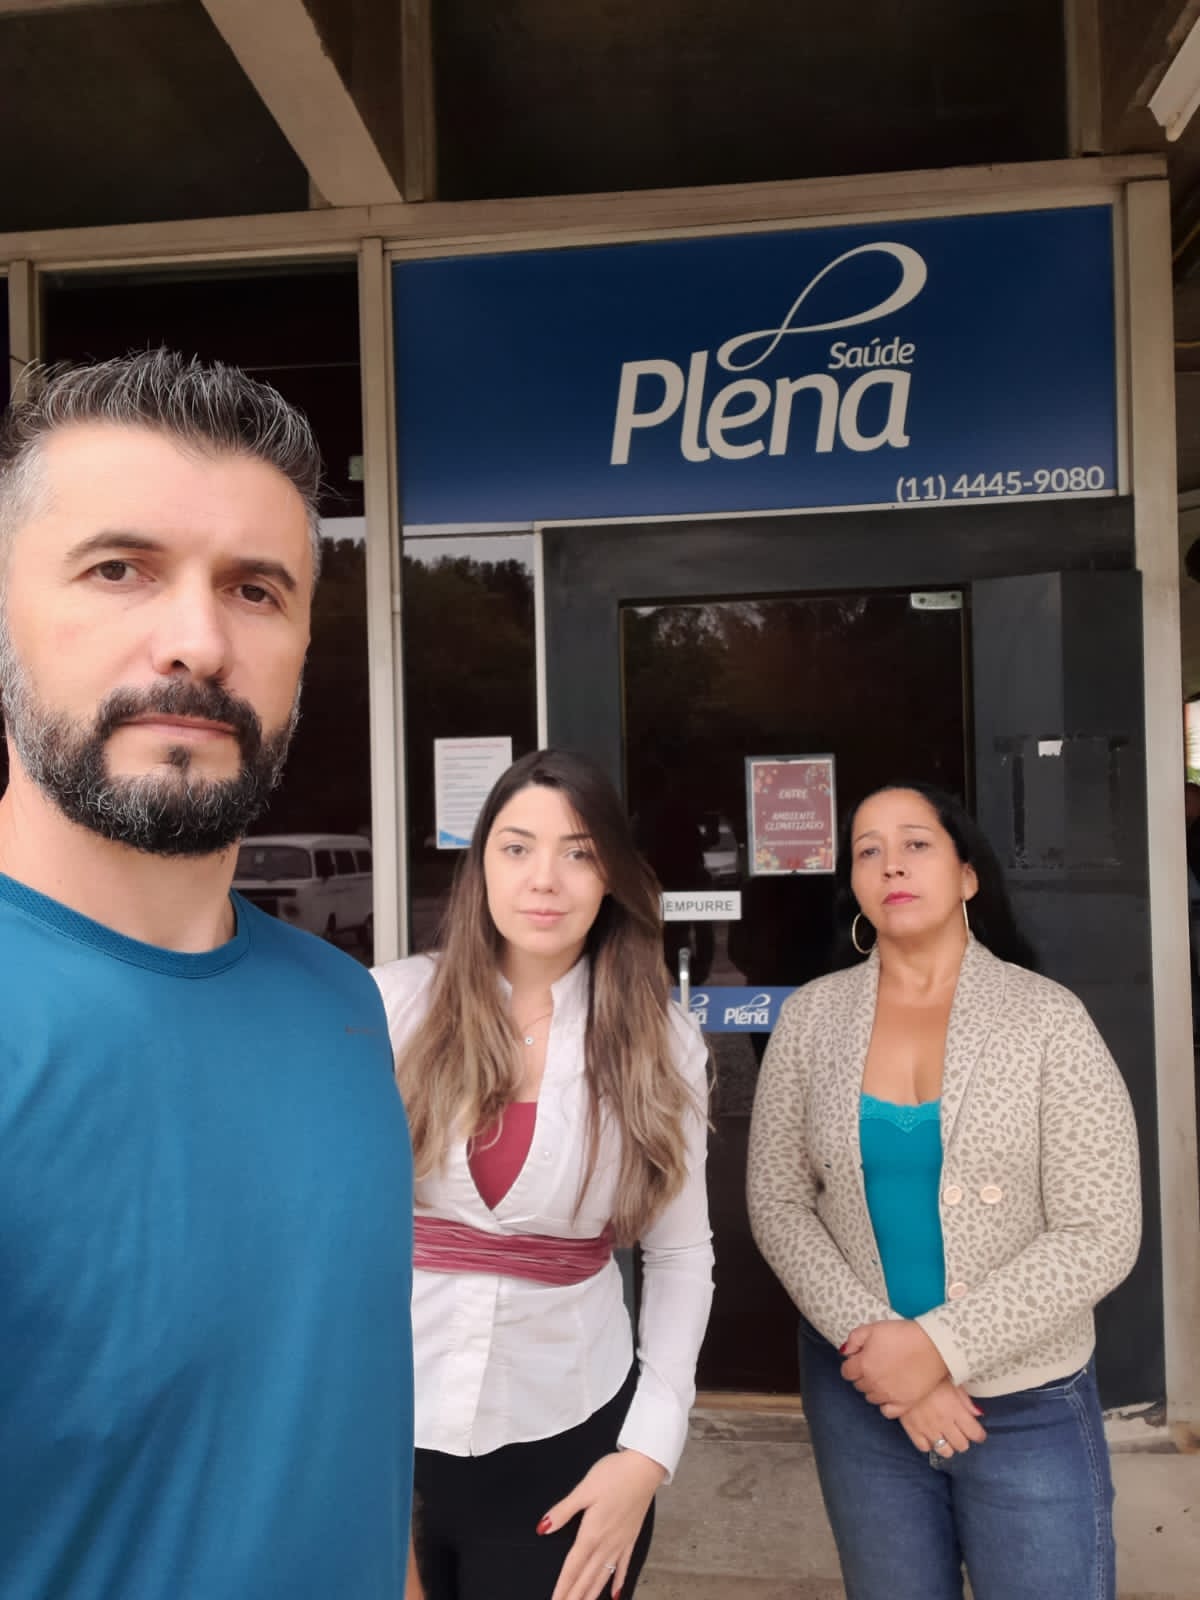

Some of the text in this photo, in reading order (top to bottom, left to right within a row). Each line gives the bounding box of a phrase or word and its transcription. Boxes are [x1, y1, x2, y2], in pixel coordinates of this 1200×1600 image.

[828, 337, 915, 369] Saúde
[610, 350, 912, 465] Plena
[896, 465, 1105, 502] (11) 4445-9080
[664, 900, 734, 912] EMPURRE
[724, 1007, 769, 1025] Plena
